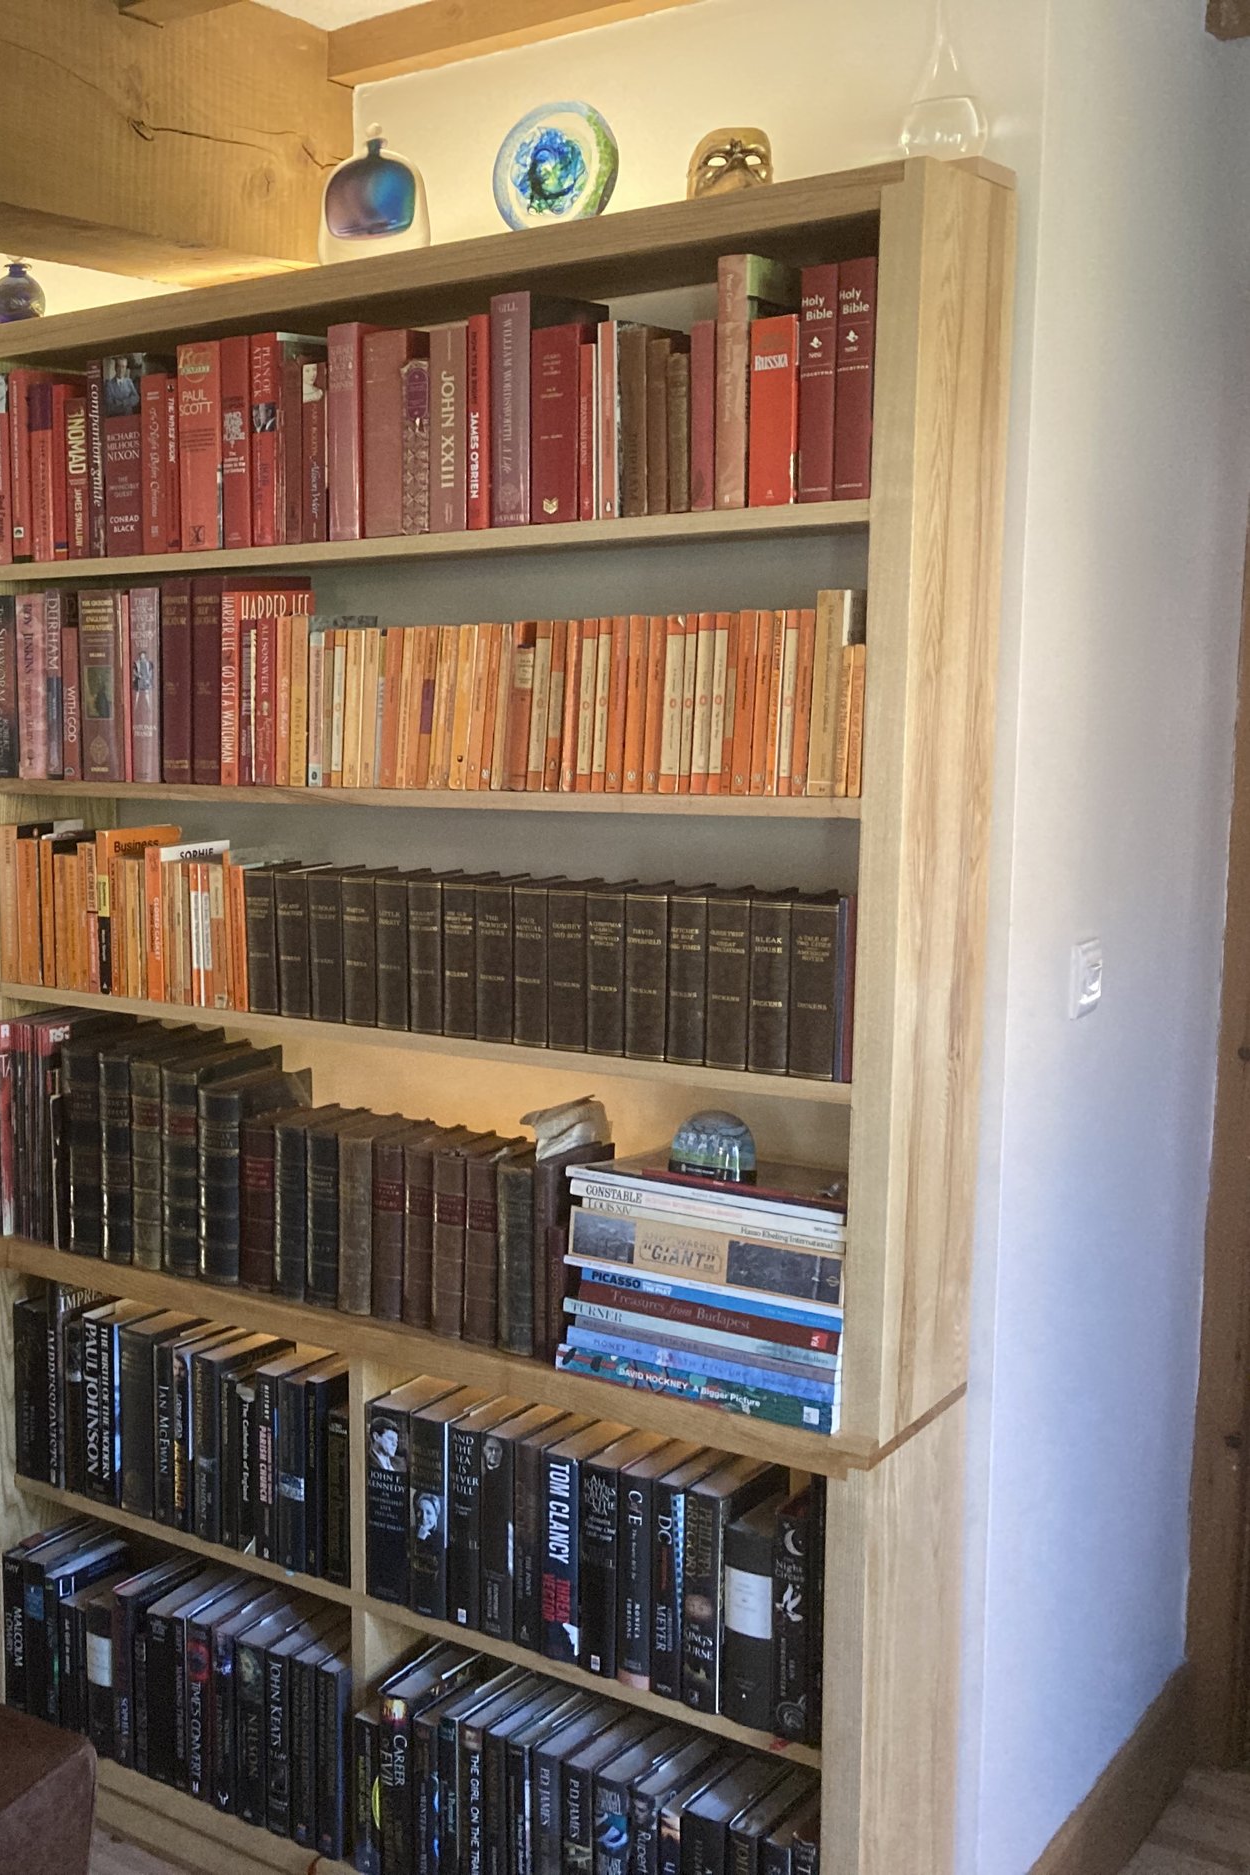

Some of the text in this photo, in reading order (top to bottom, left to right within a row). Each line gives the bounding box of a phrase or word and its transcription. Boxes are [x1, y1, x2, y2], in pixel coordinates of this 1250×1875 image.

[801, 294, 825, 309] Holy
[839, 287, 862, 302] Holy
[805, 308, 833, 321] Bible
[842, 301, 870, 315] Bible
[253, 346, 262, 398] ATTACK
[754, 353, 789, 371] RUSSKA
[182, 388, 208, 401] PAUL
[179, 401, 213, 416] SCOTT
[107, 431, 140, 441] RICHARD
[441, 370, 455, 489] JOHN XXIII
[89, 384, 102, 507] companion guide
[107, 440, 140, 450] MILHOUS
[107, 450, 140, 462] NIXON
[470, 412, 479, 499] JAMES O'BRIEN
[109, 514, 140, 524] CONRAD
[113, 523, 135, 533] BLACK
[47, 598, 60, 671] DURHAM
[23, 632, 34, 675] JENKINS
[261, 623, 269, 695] ALISON WEIR
[221, 596, 235, 764] HARPER LEE GO SET A WATCHMAN
[67, 685, 76, 743] WITH GOD
[113, 838, 160, 853] Business
[153, 897, 162, 960] CLOSED CASKET
[485, 914, 499, 922] THE
[520, 917, 536, 925] OUR
[632, 928, 654, 936] DAVID
[755, 935, 783, 944] BLEAK
[754, 946, 783, 954] HOUSE
[590, 984, 618, 993] DICKENS
[752, 999, 783, 1008] DICKENS
[586, 1184, 643, 1204] CONSTABLE
[740, 1226, 834, 1250] Hasso Ebeling International
[591, 1270, 642, 1289] PICASSO
[570, 1301, 623, 1323] TURNER
[611, 1289, 750, 1330] Treasures from Budapest
[83, 1322, 100, 1476] PAUL JOHNSON
[158, 1385, 169, 1409] IAN
[619, 1367, 762, 1407] DAVID HOCKNEY A Bigger Picture
[101, 1327, 111, 1480] THE BIRTH OF THE MODERN
[452, 1433, 474, 1445] AND
[454, 1443, 473, 1455] THE
[241, 1403, 250, 1502] The Cathedrals of England
[259, 1425, 268, 1502] PARISH CHURCH
[455, 1454, 471, 1465] SEA
[370, 1471, 393, 1483] JOHN
[450, 1472, 479, 1487] NEVER
[458, 1464, 467, 1474] IS
[367, 1480, 406, 1494] KENNEDY
[452, 1483, 474, 1496] FULL
[548, 1462, 570, 1565] TOM CLANCY
[656, 1514, 673, 1546] DC
[685, 1495, 699, 1581] GREGORY
[697, 1506, 712, 1579] PHILIPPA
[12, 1606, 24, 1667] MALCOLM
[655, 1603, 667, 1652] MEYER
[268, 1659, 284, 1748] JOHN KEATS
[190, 1719, 203, 1781] CONVERT
[248, 1712, 259, 1778] NELSON
[379, 1750, 394, 1787] EVIL
[393, 1734, 408, 1787] CAREER
[470, 1753, 480, 1848] THE GIRL ON THE
[569, 1800, 580, 1840] JAMES
[637, 1830, 651, 1872] Rupert
